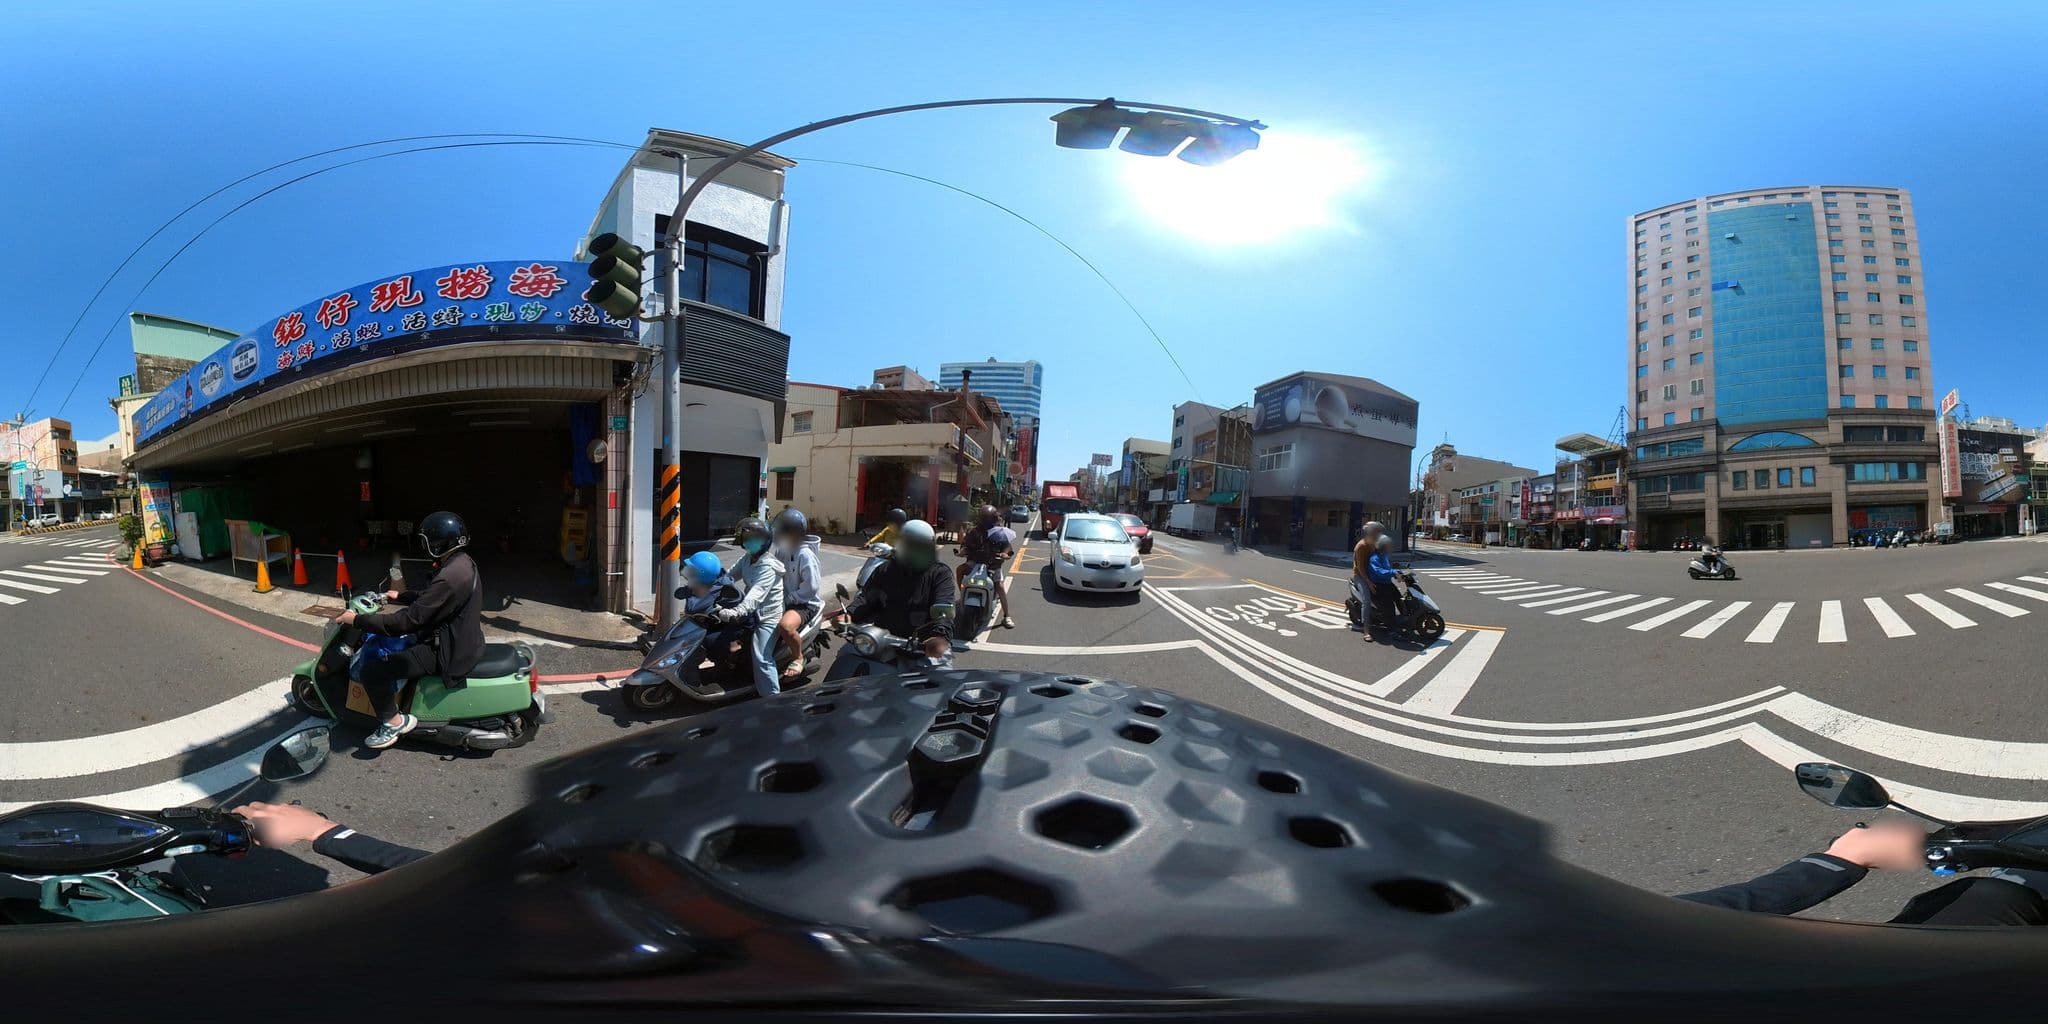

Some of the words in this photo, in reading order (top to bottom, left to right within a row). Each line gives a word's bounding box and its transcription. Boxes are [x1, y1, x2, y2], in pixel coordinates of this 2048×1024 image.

[273, 263, 601, 347] 銘仔現撈海
